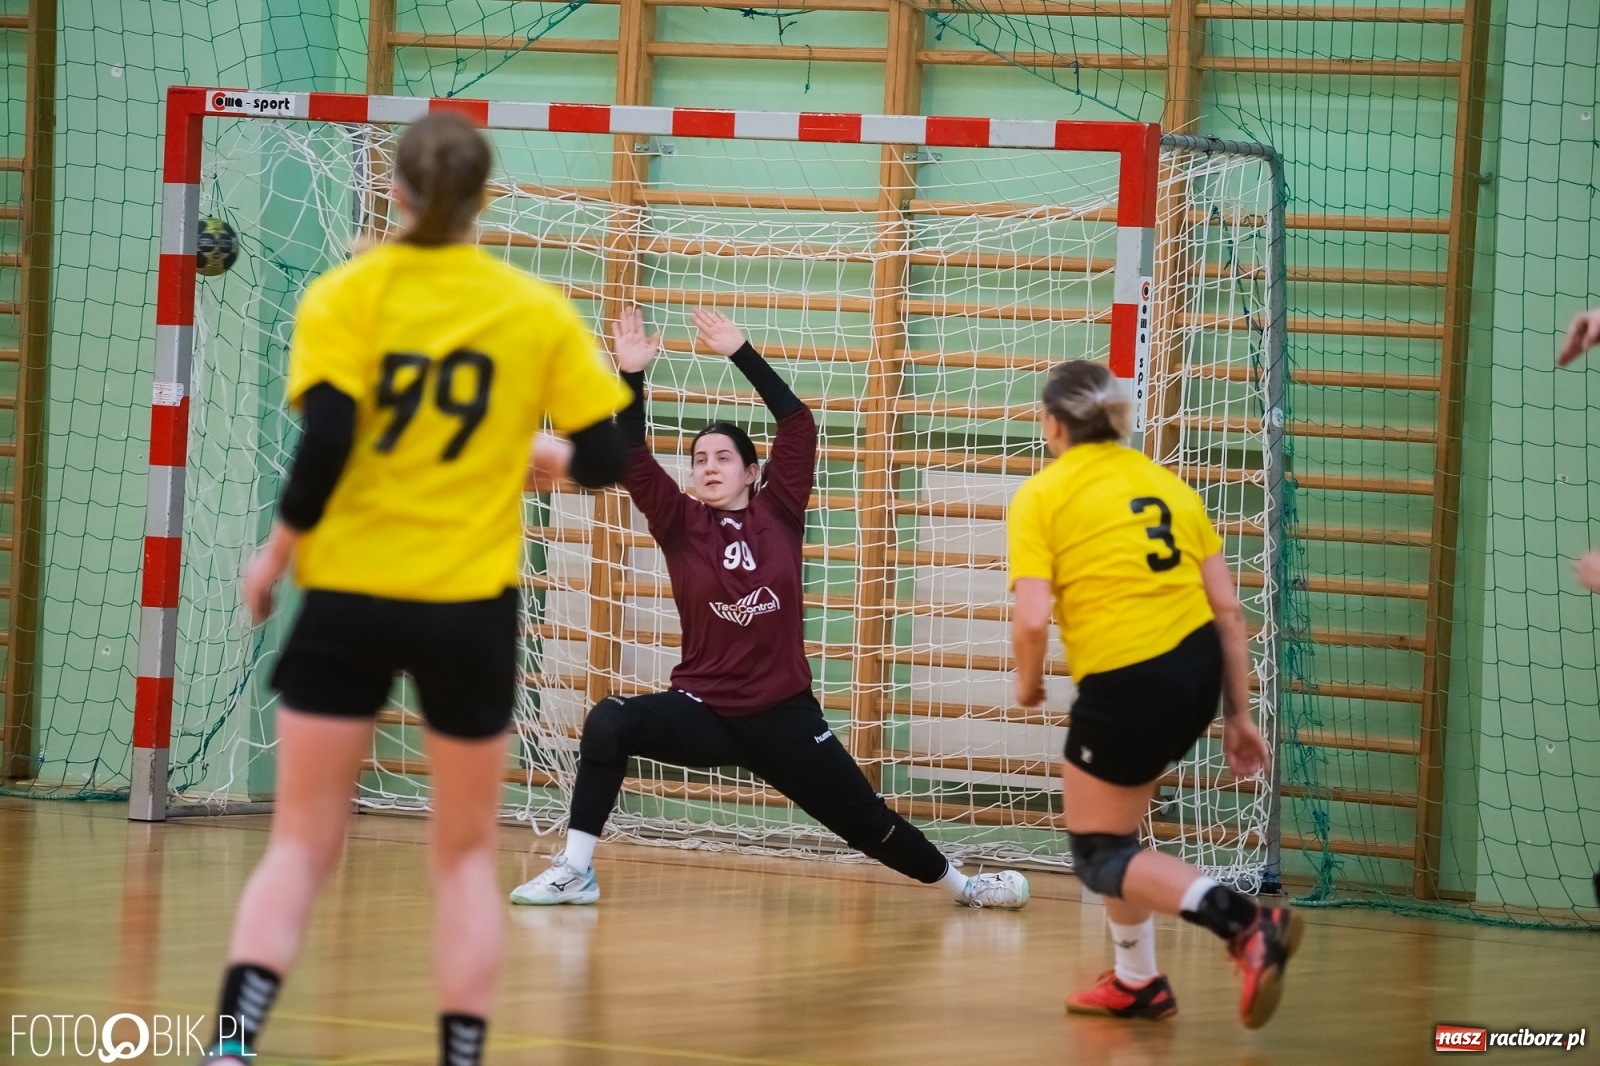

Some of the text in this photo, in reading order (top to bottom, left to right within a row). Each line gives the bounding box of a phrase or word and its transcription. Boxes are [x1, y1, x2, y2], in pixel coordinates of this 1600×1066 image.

[253, 97, 291, 112] sport
[374, 348, 495, 463] 99
[1129, 496, 1182, 573] 3
